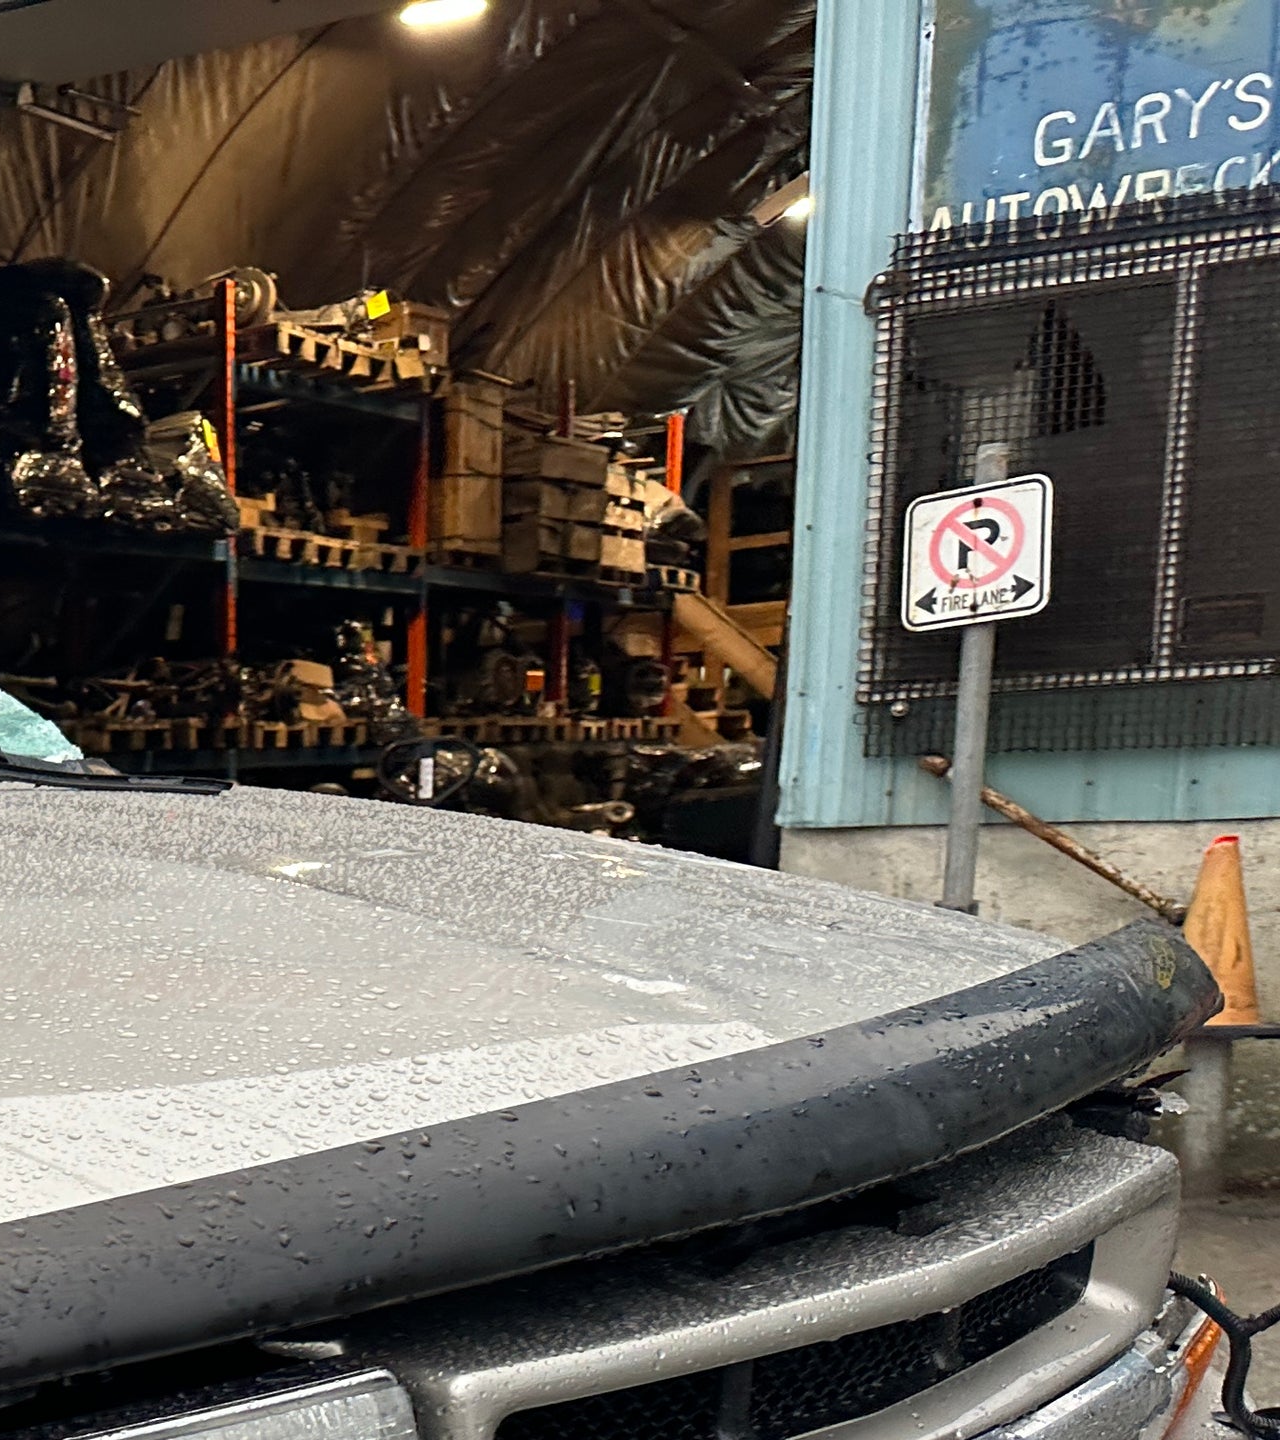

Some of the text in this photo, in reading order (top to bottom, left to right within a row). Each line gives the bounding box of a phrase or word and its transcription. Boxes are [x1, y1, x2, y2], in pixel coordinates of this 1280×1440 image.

[1033, 71, 1273, 168] GARY'S
[941, 587, 1010, 614] FIRE LANE
